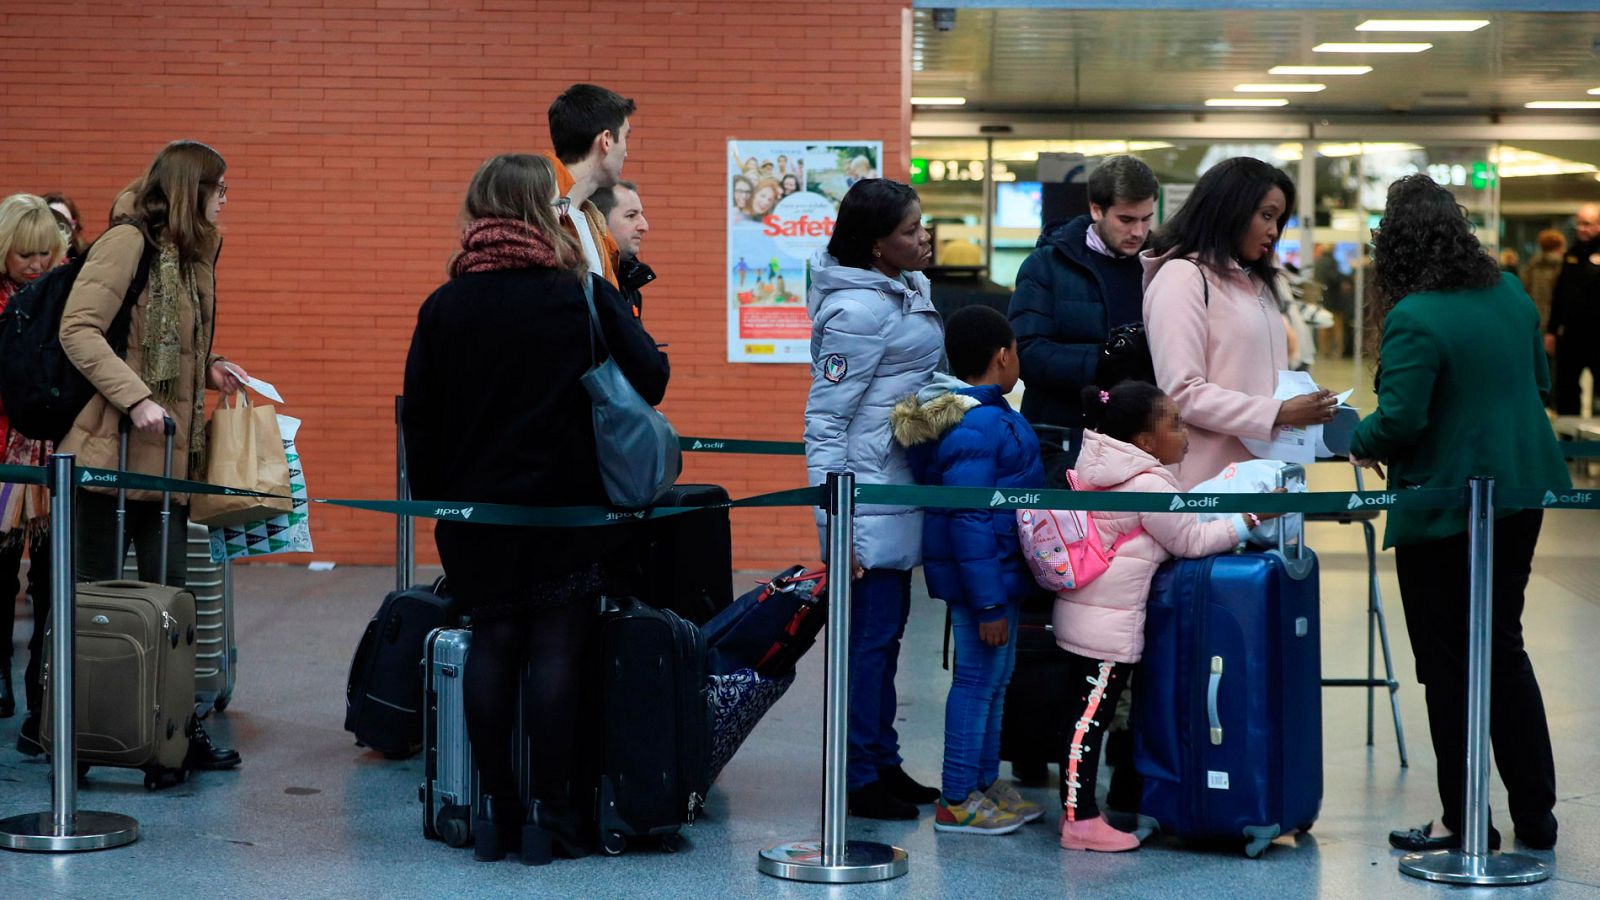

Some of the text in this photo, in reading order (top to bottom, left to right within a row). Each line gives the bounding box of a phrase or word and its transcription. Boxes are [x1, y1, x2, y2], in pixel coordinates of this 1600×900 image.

[763, 214, 837, 237] Safet
[94, 474, 119, 483] adif
[1007, 493, 1041, 504] adif
[1186, 496, 1220, 508] adif
[1364, 494, 1397, 505] adif
[1560, 493, 1593, 503] adif
[434, 507, 460, 516] adif
[605, 512, 632, 520] adif
